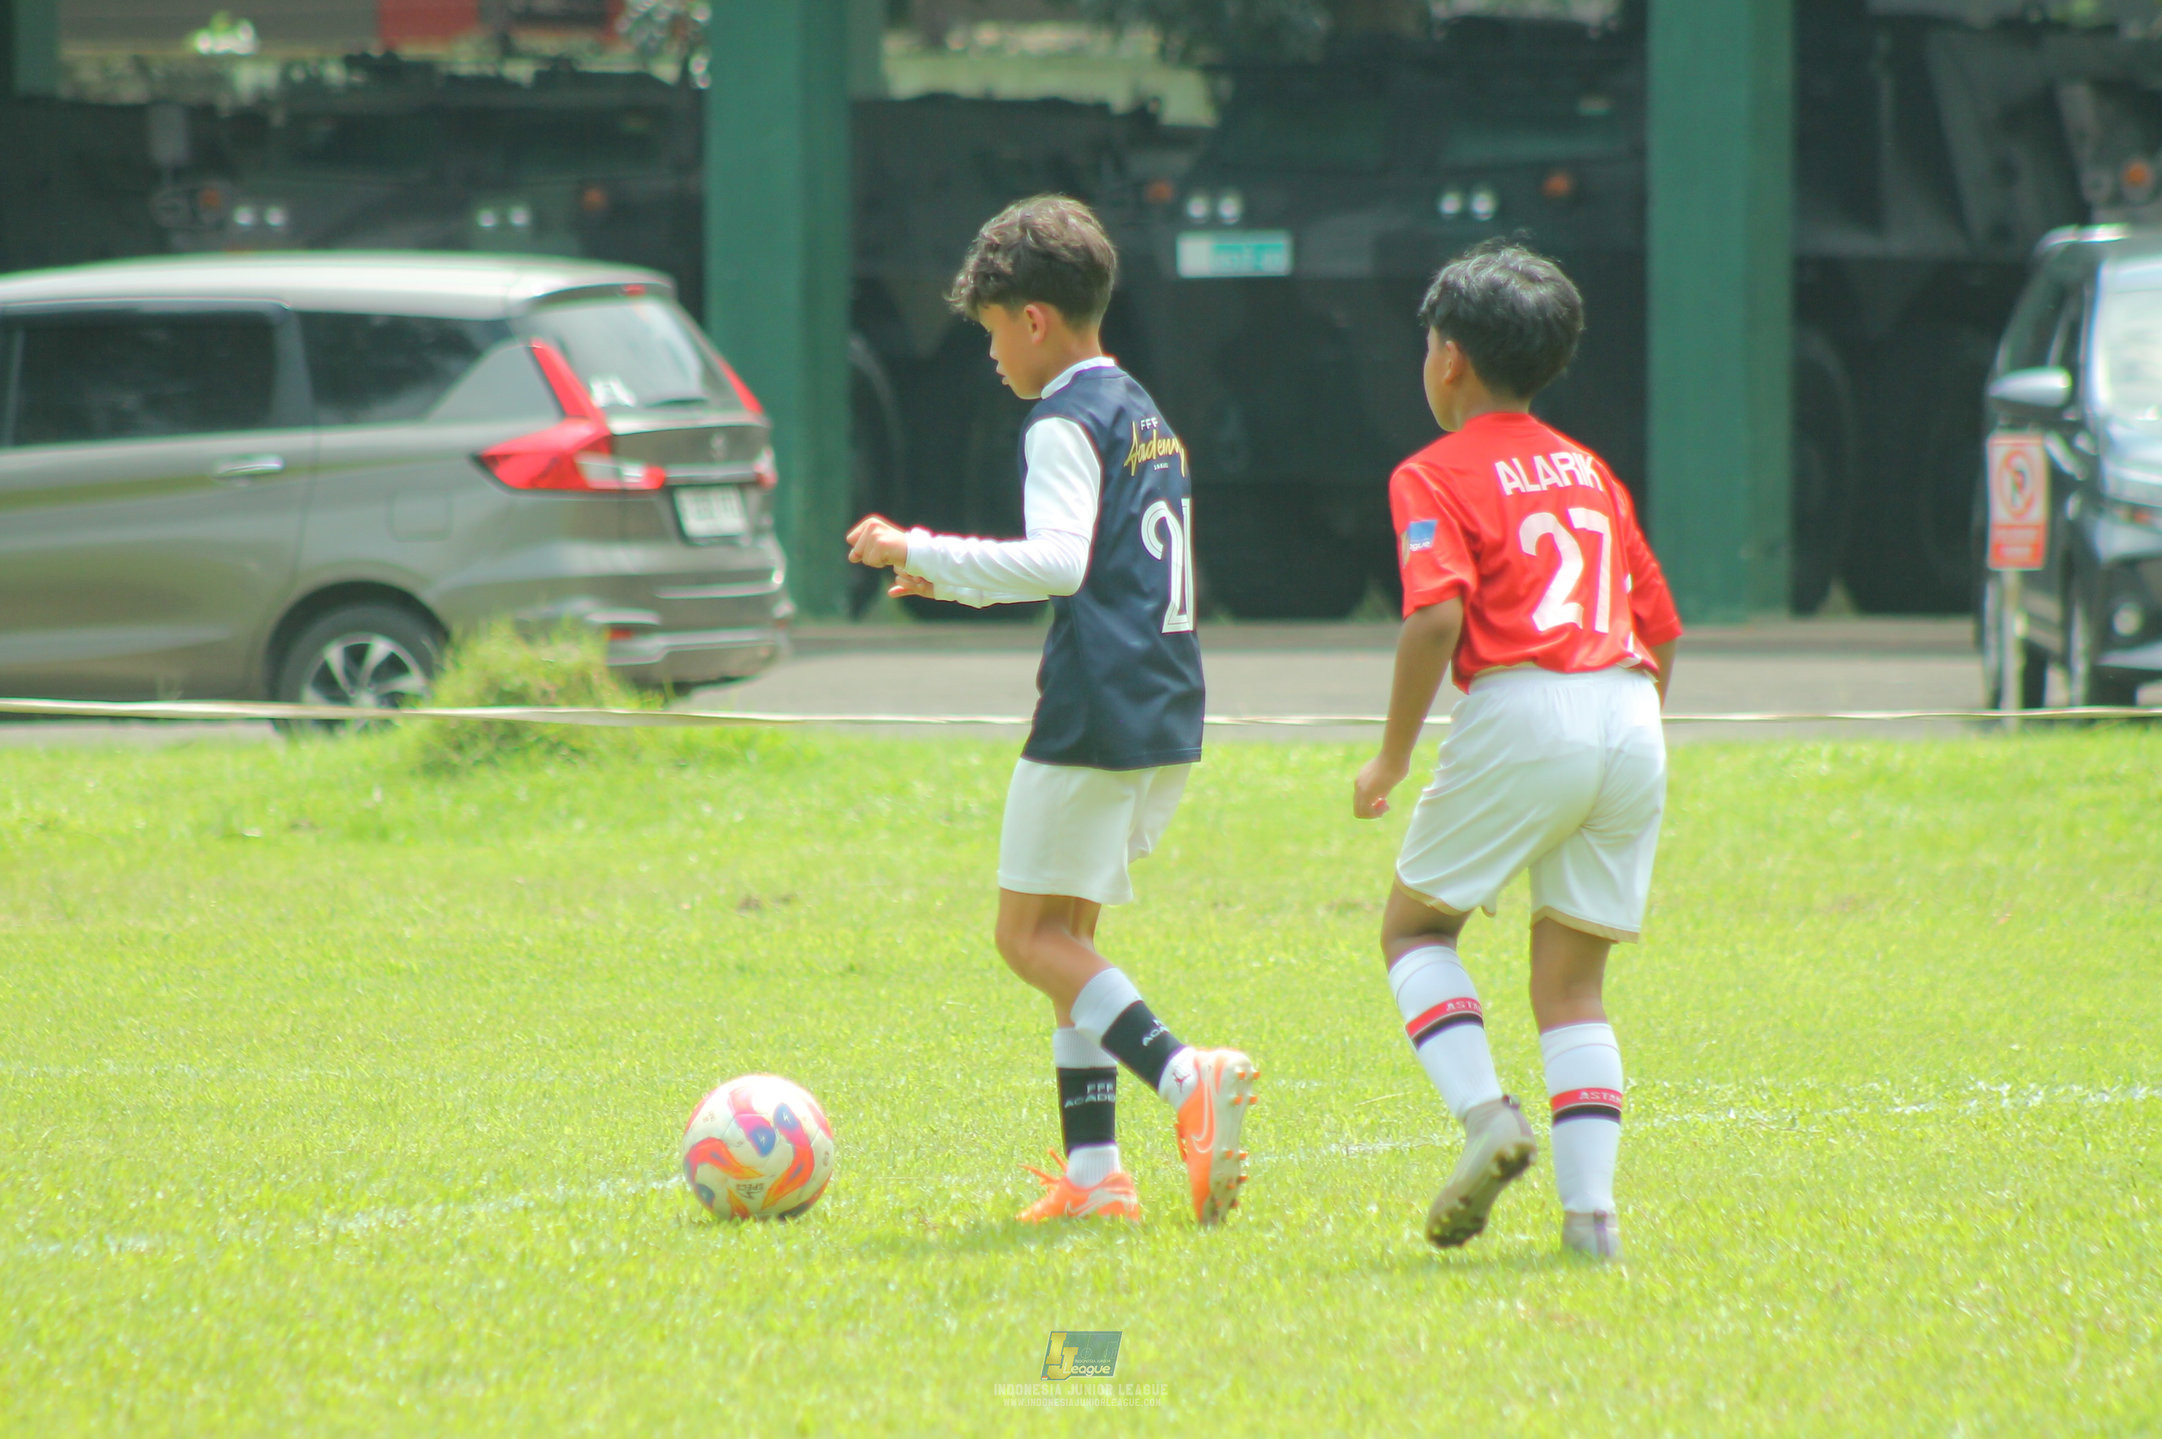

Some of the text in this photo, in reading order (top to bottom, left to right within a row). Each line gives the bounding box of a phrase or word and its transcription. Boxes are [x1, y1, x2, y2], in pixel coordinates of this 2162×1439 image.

[1140, 417, 1158, 430] FFF
[1495, 452, 1604, 495] ALARIK
[1141, 498, 1194, 633] 21
[1518, 507, 1612, 633] 27
